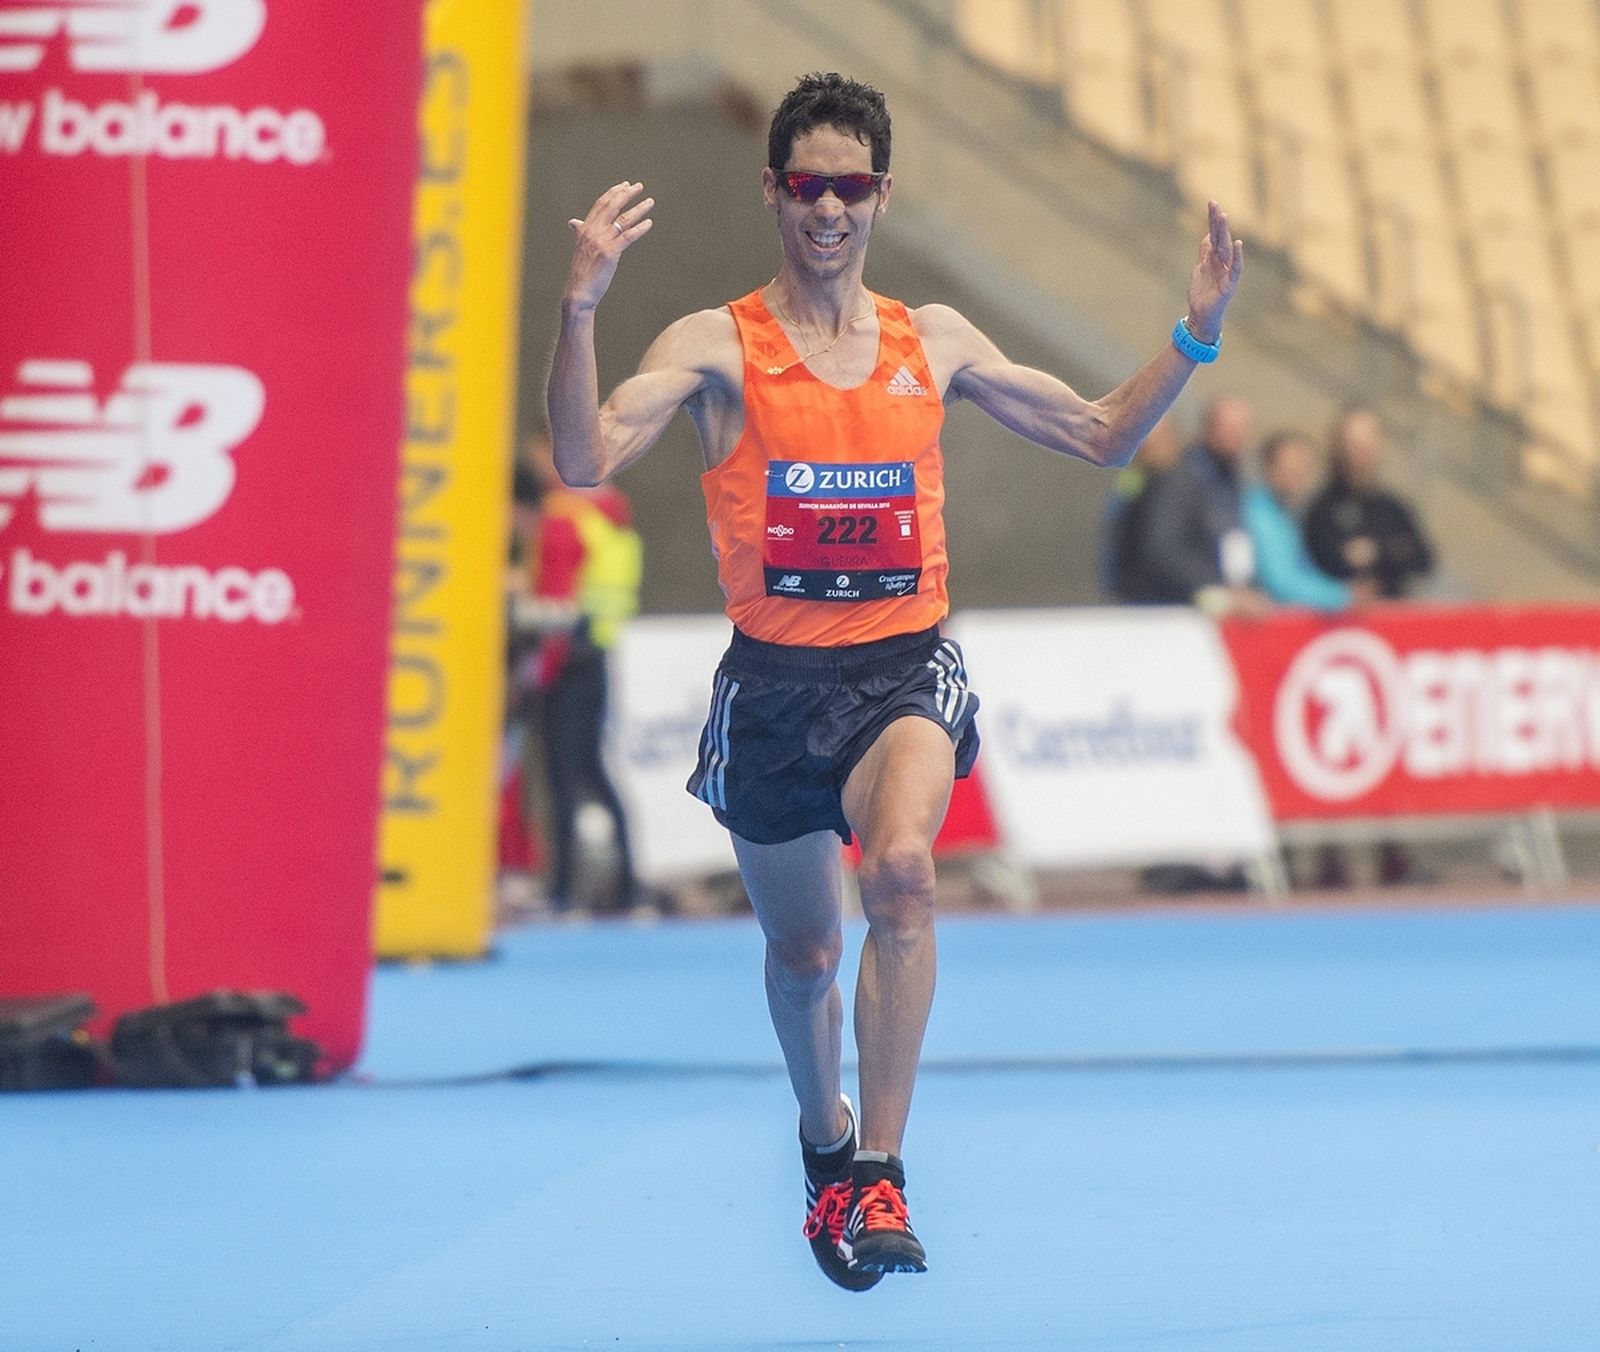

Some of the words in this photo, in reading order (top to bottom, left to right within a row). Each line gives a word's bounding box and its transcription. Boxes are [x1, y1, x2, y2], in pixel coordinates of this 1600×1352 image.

[40, 88, 326, 165] balance
[887, 383, 928, 396] adidas
[819, 468, 901, 489] ZURICH
[817, 516, 877, 545] 222
[820, 556, 869, 567] GUERRA
[9, 547, 296, 624] balance
[825, 589, 860, 598] ZURICH
[1401, 646, 1600, 778] ENER
